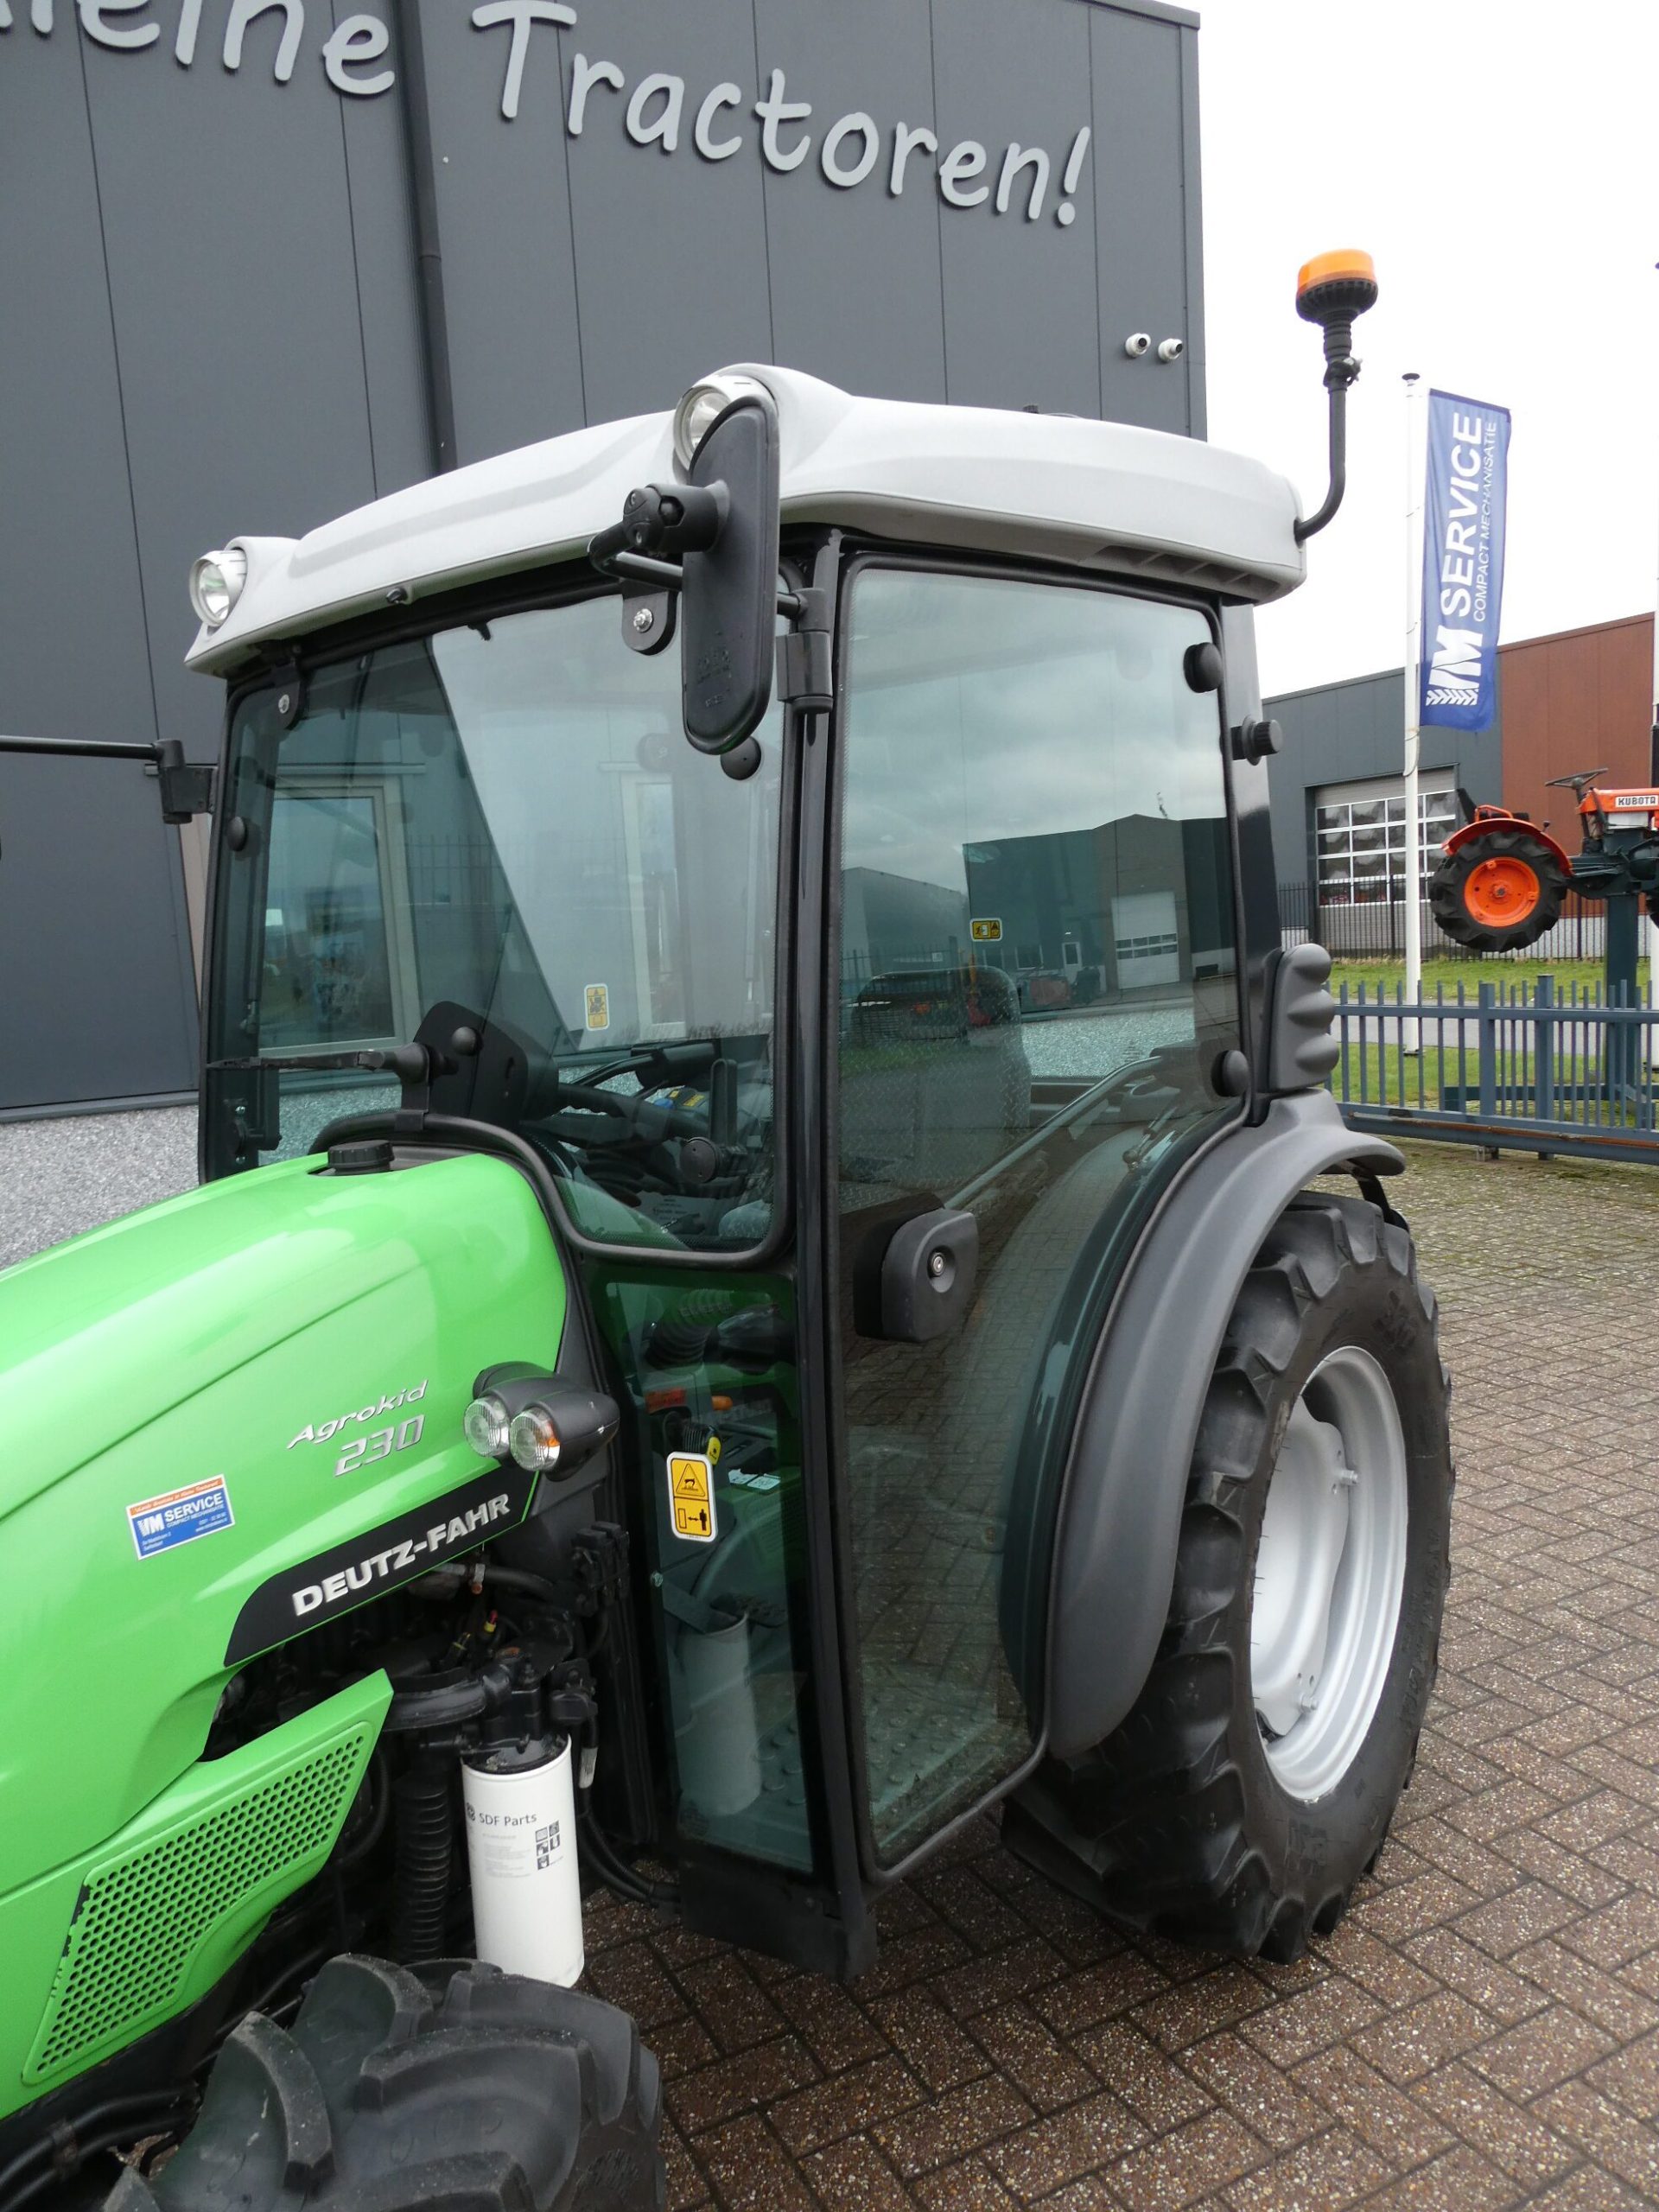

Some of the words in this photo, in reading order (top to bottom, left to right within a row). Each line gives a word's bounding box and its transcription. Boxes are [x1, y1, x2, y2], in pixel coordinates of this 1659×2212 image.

[0, 0, 395, 95] eine
[472, 0, 1090, 226] Tractoren!
[1440, 412, 1482, 618] SERVICE
[1478, 420, 1497, 542] MECHANISATIE
[1473, 545, 1491, 623] COMPACT
[1618, 796, 1656, 806] KUBOTA
[286, 1379, 429, 1450] Agrokid
[334, 1414, 425, 1478] 230
[164, 1491, 225, 1522] SERVICE
[291, 1493, 512, 1617] DEUTZ-FAHR
[479, 1813, 500, 1827] SDF
[504, 1813, 537, 1827] Parts
